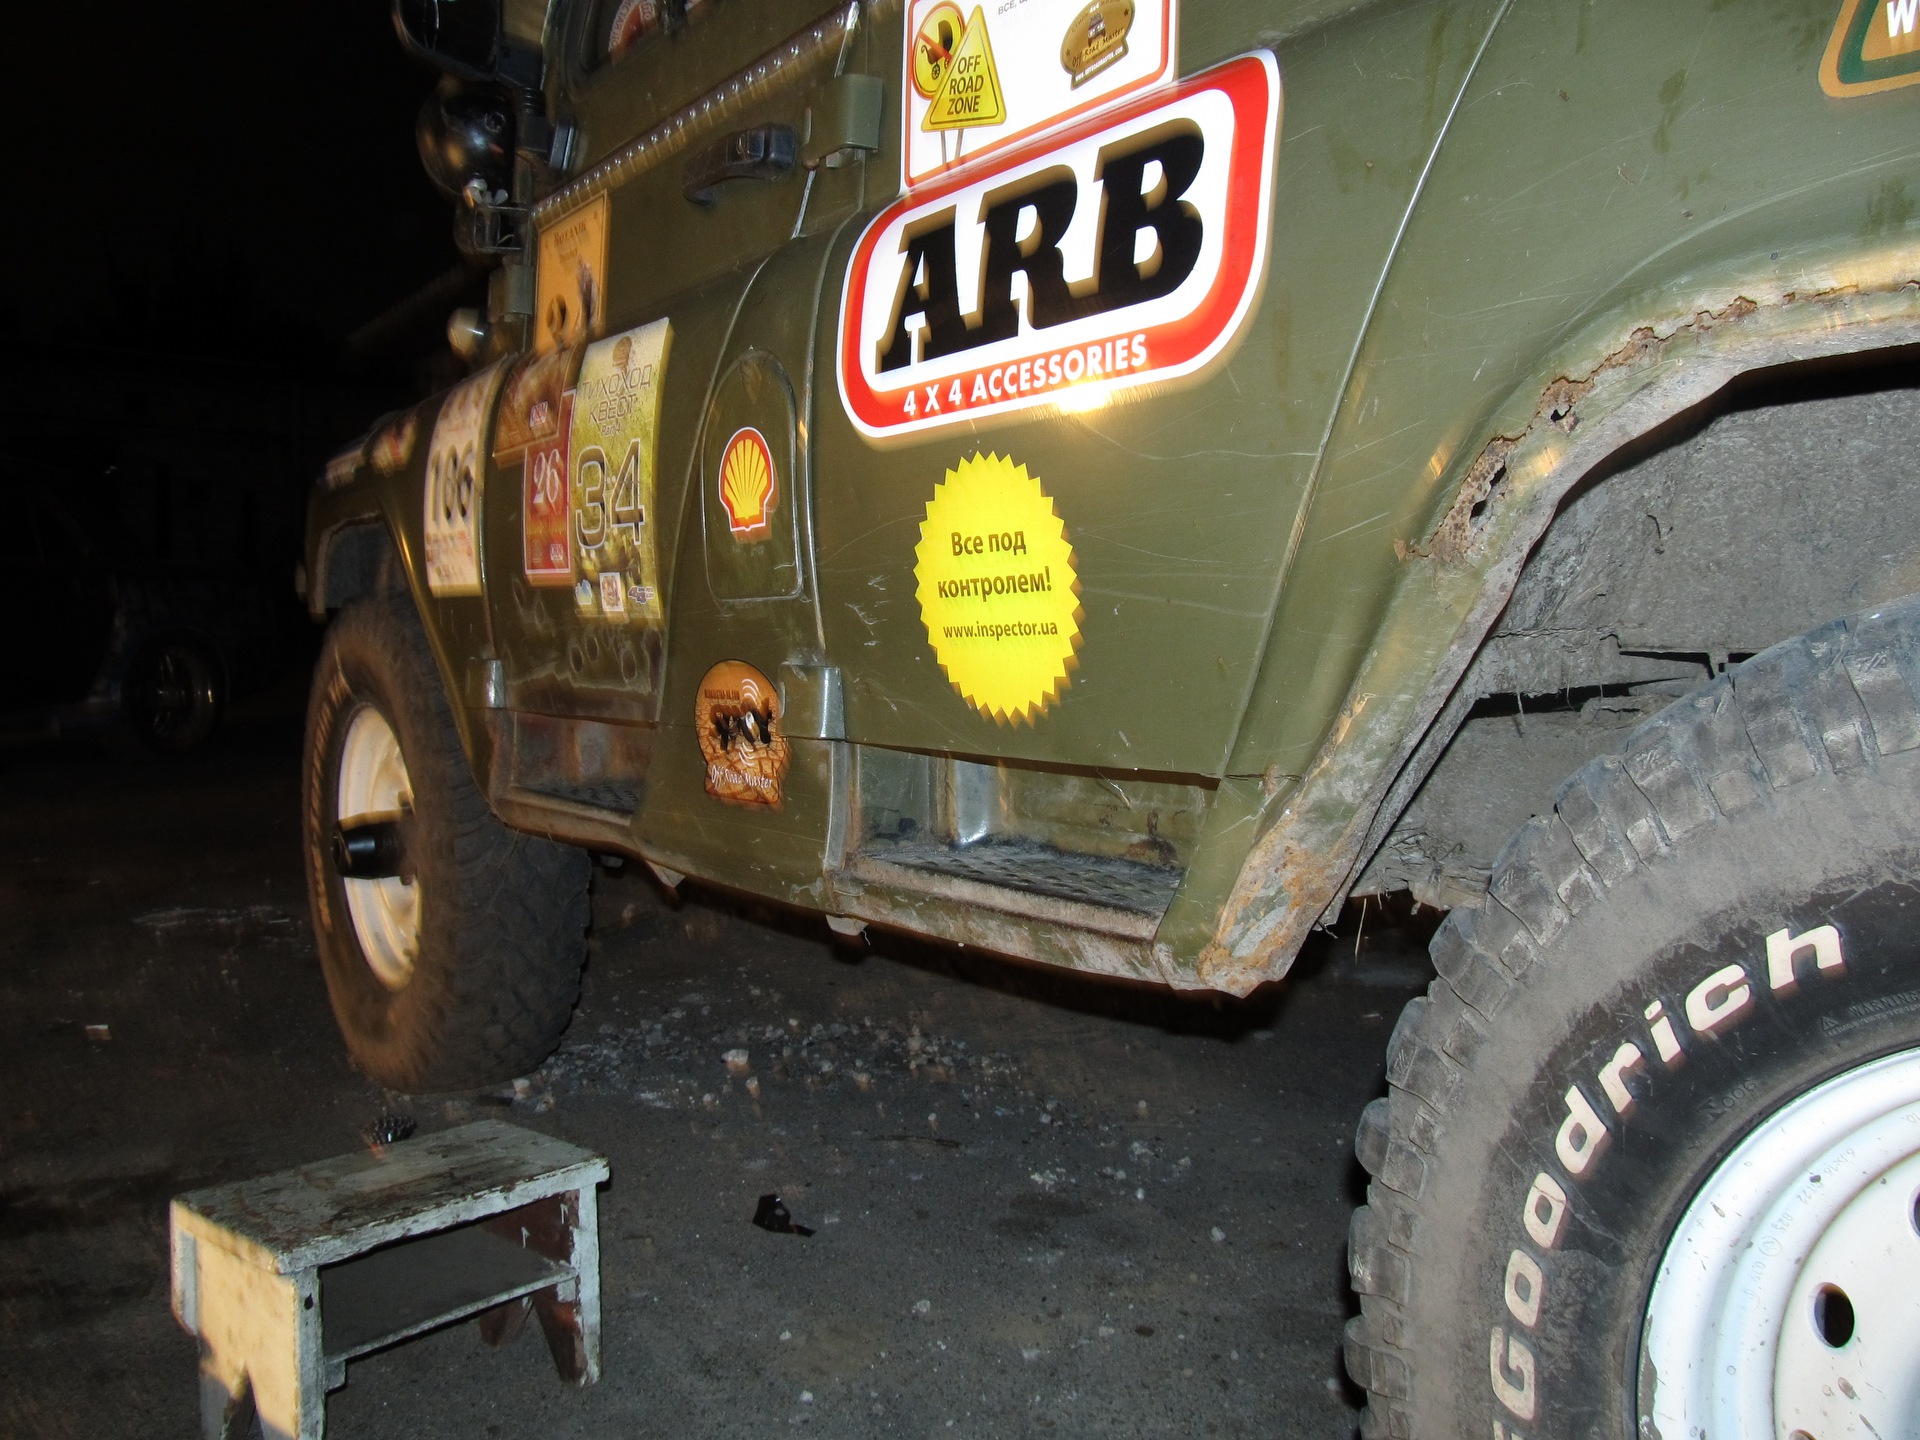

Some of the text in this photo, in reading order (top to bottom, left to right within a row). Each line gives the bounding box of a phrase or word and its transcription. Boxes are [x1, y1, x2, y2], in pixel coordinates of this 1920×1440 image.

[1887, 0, 1920, 37] W
[957, 54, 982, 75] OFF
[948, 74, 985, 96] ROAD
[946, 94, 981, 116] ZONE
[875, 118, 1204, 374] ARB
[582, 363, 652, 401] ТИХОХОД
[903, 390, 917, 416] 4
[948, 378, 963, 406] 4
[970, 333, 1148, 403] ACCESSORIES
[589, 393, 637, 424] КВЕСТ
[576, 437, 646, 550] 34
[951, 530, 1027, 557] Все под
[937, 566, 1052, 603] контролем!
[943, 620, 1058, 642] www.inspector.ua
